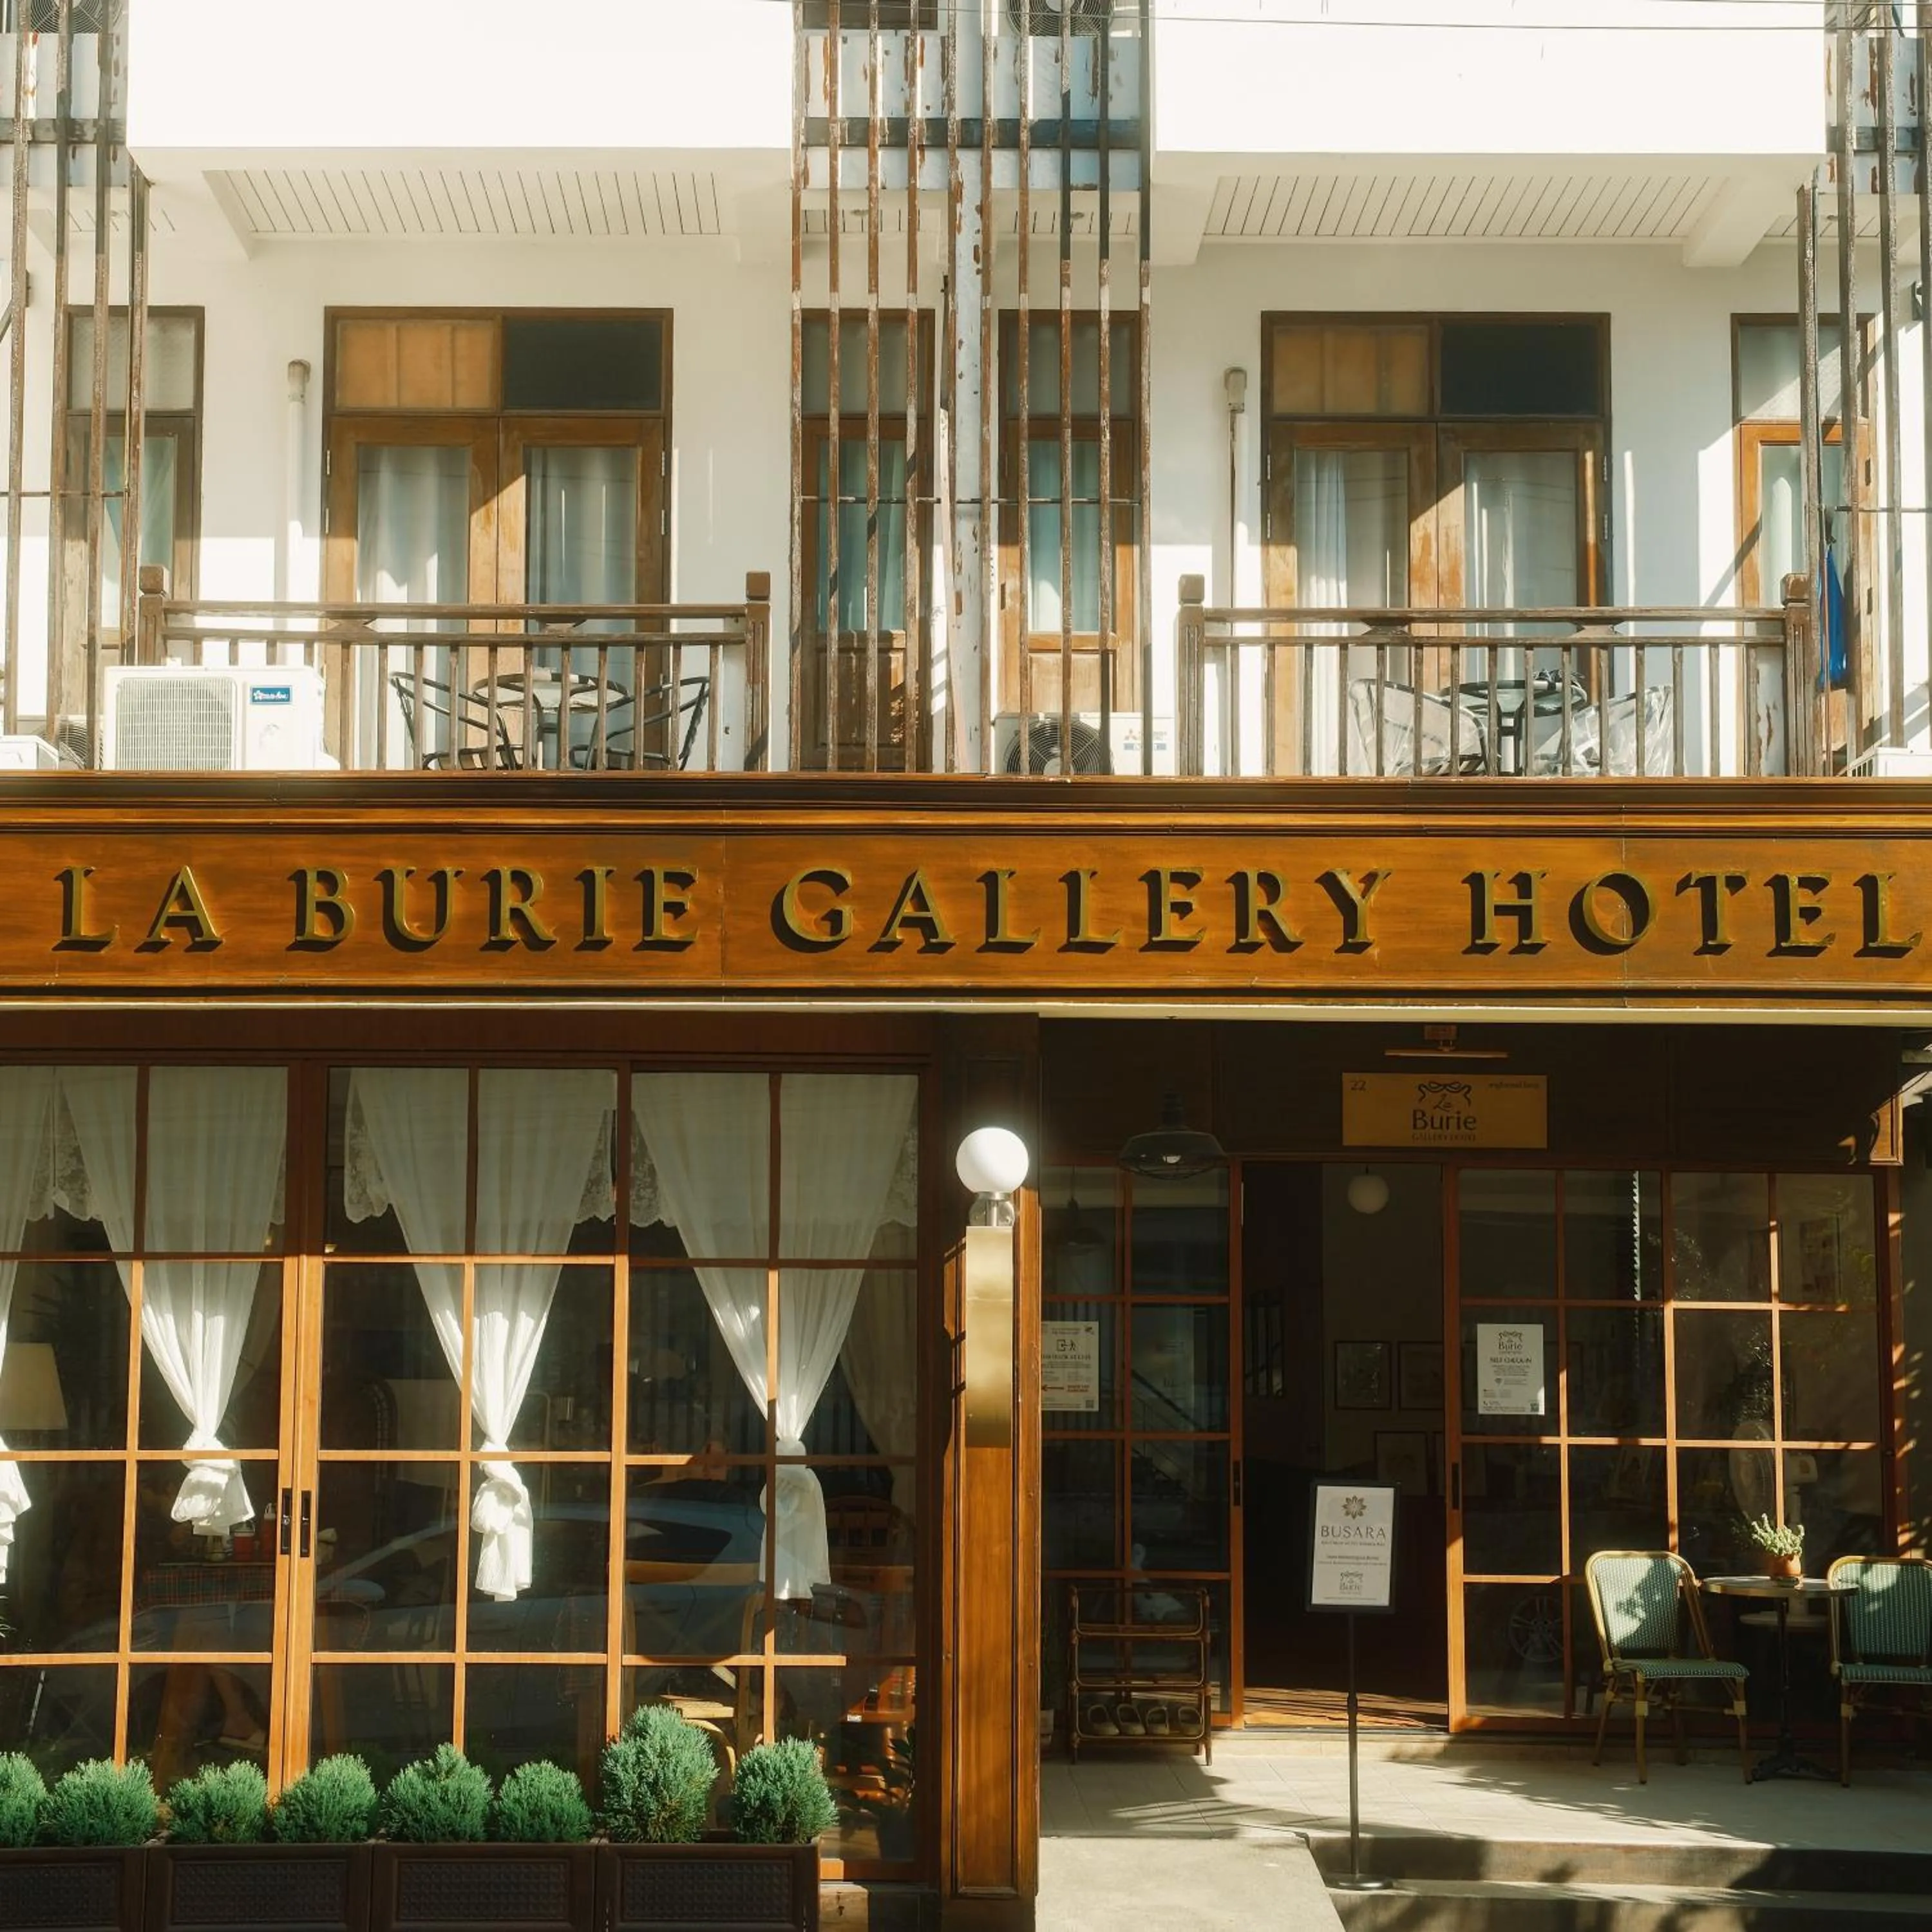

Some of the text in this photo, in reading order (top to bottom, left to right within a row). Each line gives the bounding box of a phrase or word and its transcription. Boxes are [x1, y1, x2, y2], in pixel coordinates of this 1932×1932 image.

[52, 864, 1924, 959] LA BURIE GALLERY HOTEL
[1350, 1079, 1367, 1092] 22
[1412, 1109, 1477, 1131] Burie
[1321, 1525, 1386, 1539] BUSARA
